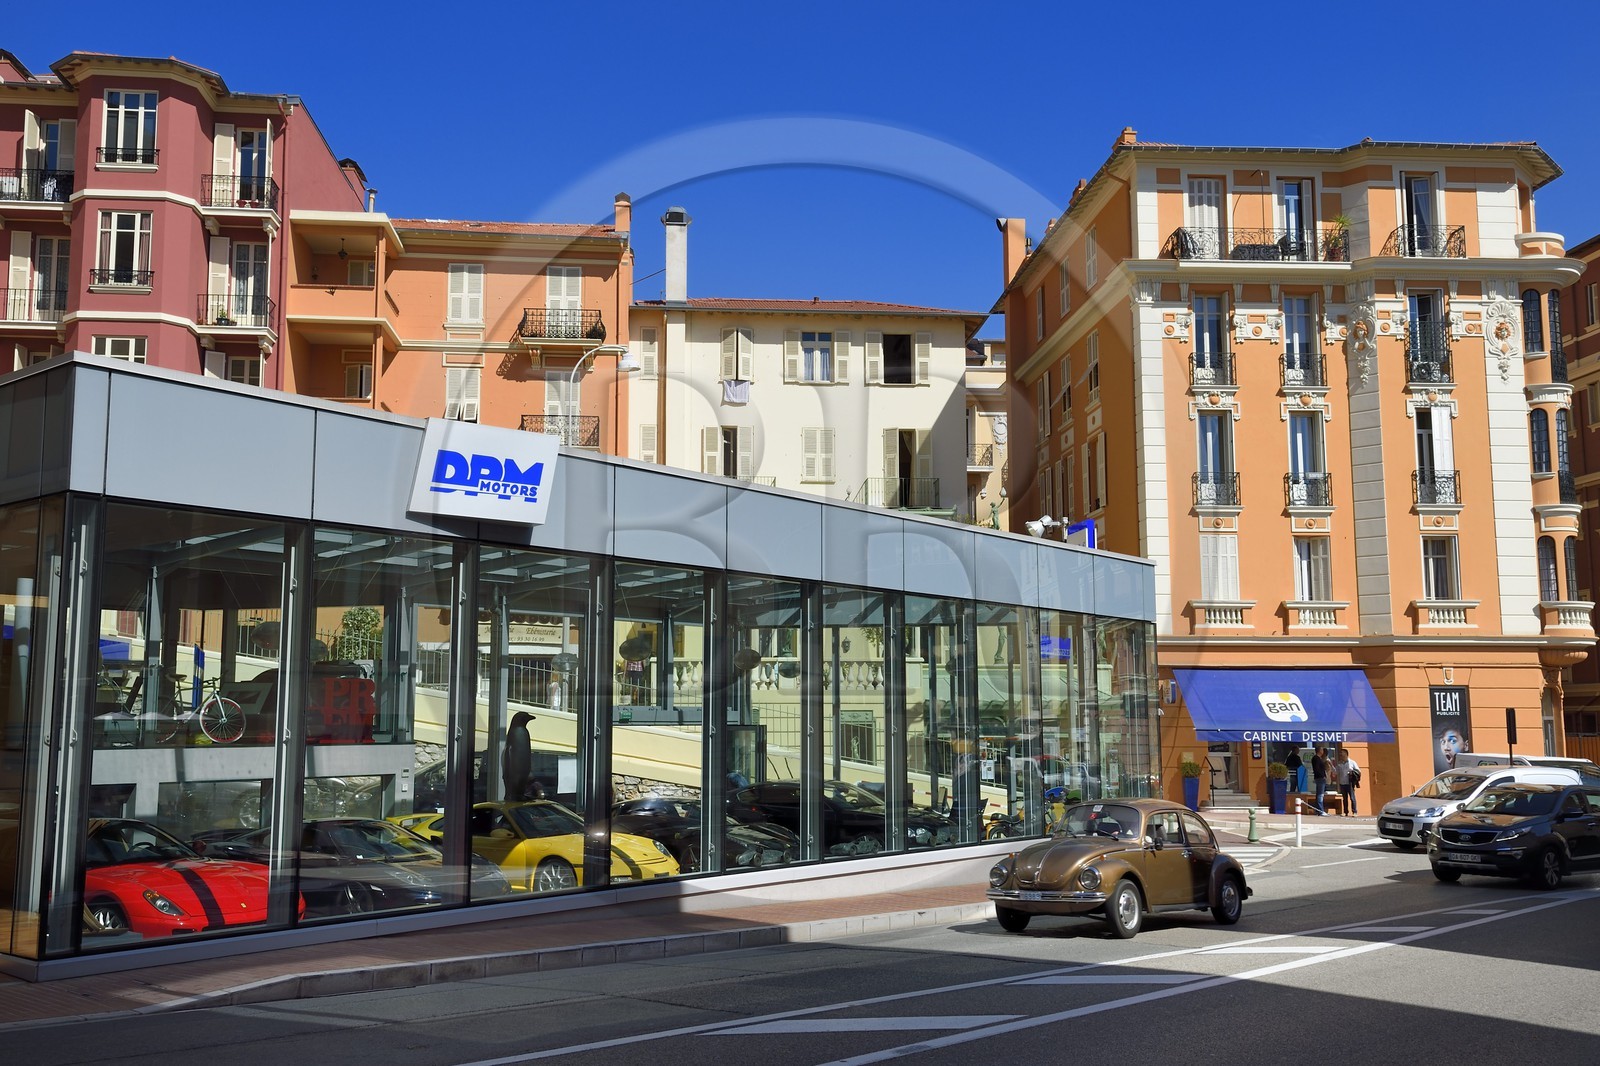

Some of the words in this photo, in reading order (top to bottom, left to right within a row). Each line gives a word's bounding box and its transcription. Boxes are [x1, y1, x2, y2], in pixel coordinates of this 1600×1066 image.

[479, 480, 538, 497] MOTORS
[1266, 702, 1301, 714] gan
[1434, 692, 1460, 711] TEAM
[1243, 731, 1293, 742] CABINET
[1302, 732, 1348, 742] DESMET
